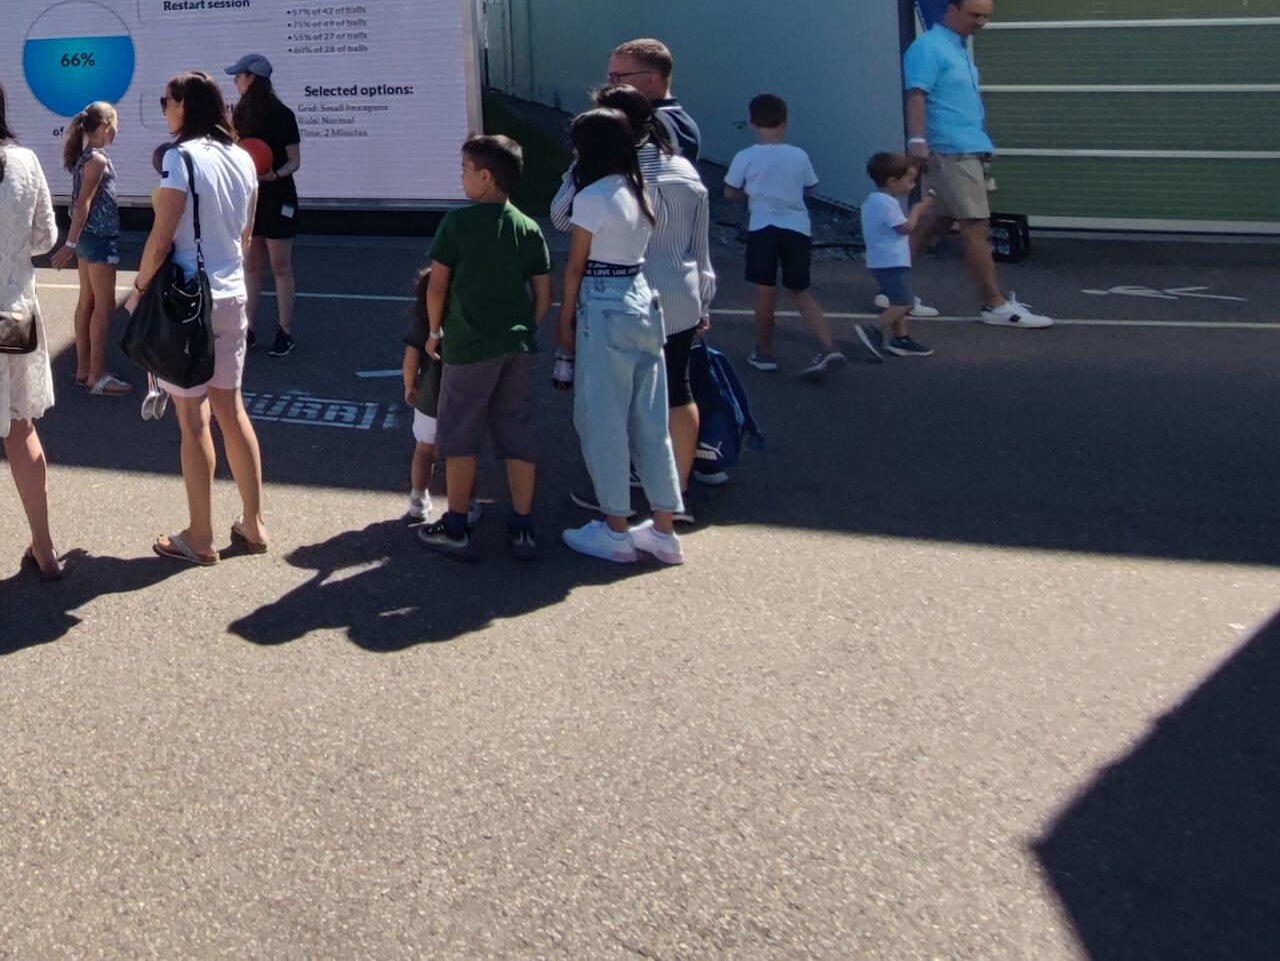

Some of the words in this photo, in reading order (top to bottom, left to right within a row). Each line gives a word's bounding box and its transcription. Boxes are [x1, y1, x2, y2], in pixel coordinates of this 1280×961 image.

[163, 0, 206, 11] Restart
[312, 7, 321, 16] of
[322, 7, 334, 16] 42
[335, 7, 345, 15] of
[346, 5, 367, 14] balls
[312, 20, 321, 28] of
[336, 19, 345, 28] of
[346, 18, 367, 27] balls
[312, 33, 322, 41] of
[336, 32, 345, 40] of
[346, 31, 368, 40] balls
[313, 45, 322, 54] of
[336, 44, 346, 53] of
[347, 44, 368, 53] balls
[60, 52, 95, 68] 66%
[304, 85, 358, 97] Selected
[360, 84, 414, 97] options:
[297, 104, 319, 113] Grid:
[320, 104, 345, 112] Small
[345, 104, 389, 113] hexagons
[298, 117, 320, 125] Rule:
[321, 117, 355, 125] Normal
[299, 129, 322, 138] Time:
[324, 129, 330, 137] 2
[331, 128, 368, 137] Minutes
